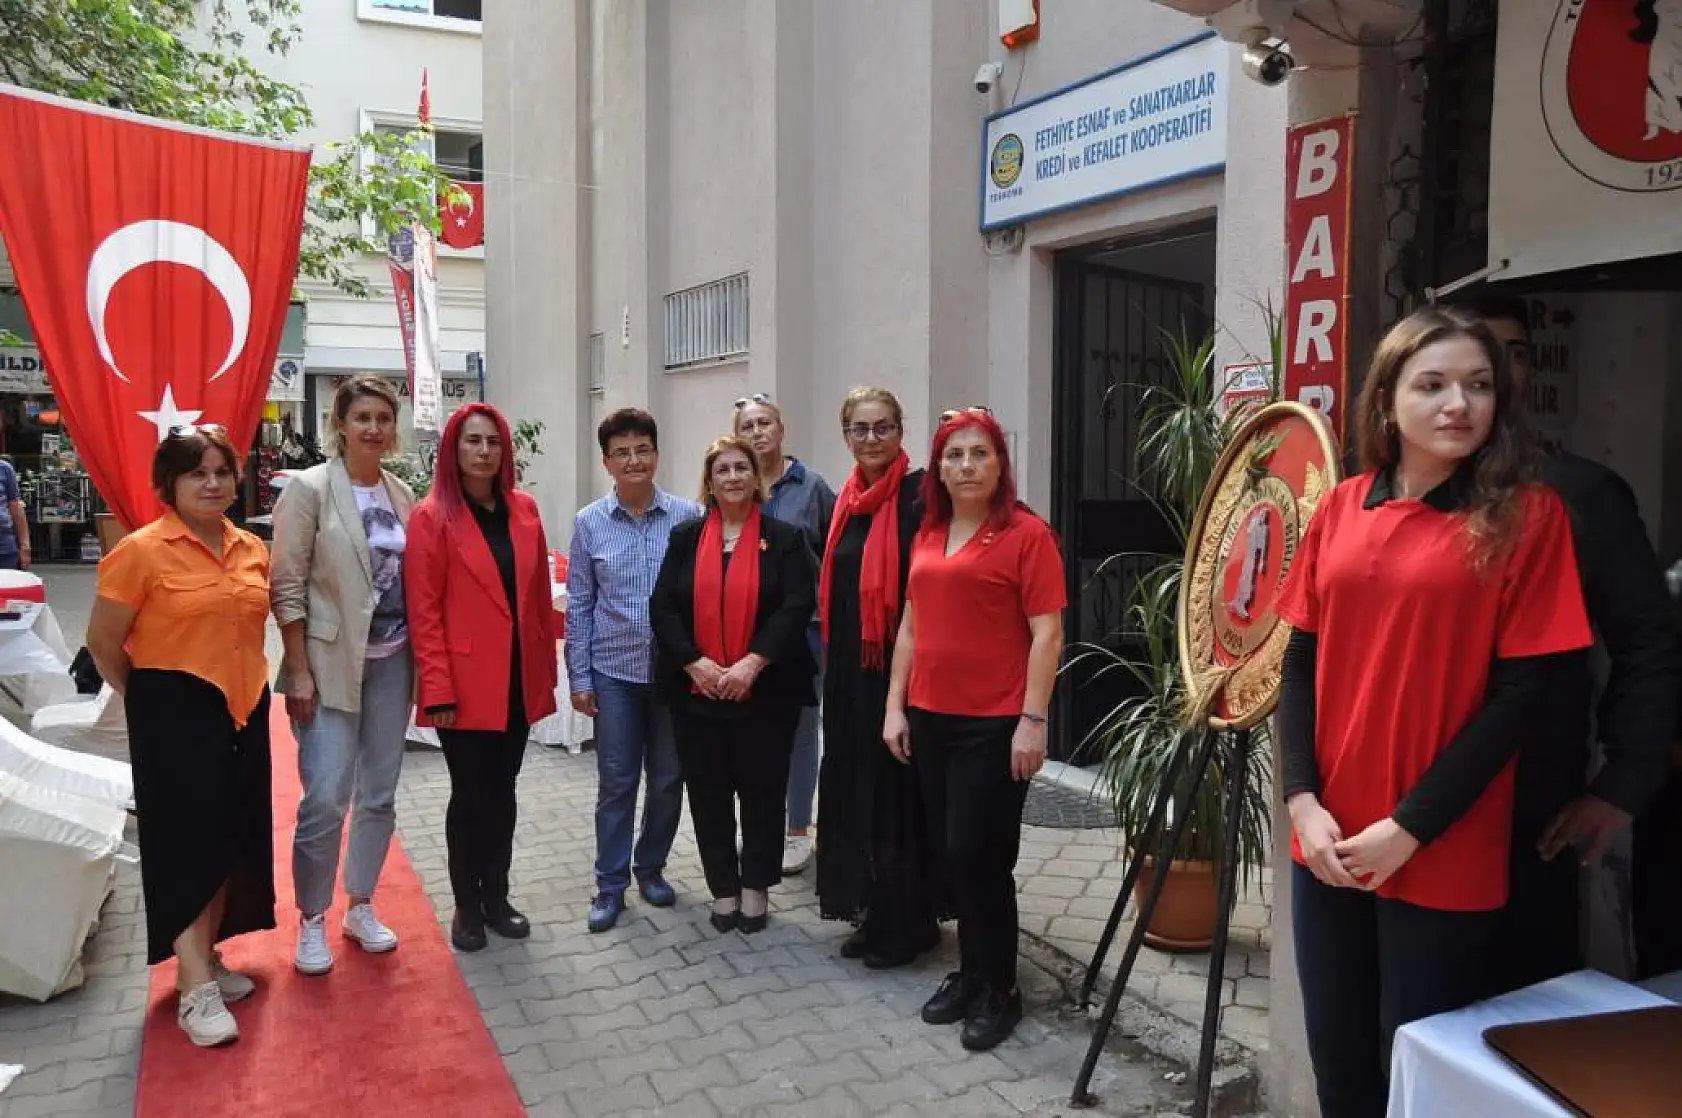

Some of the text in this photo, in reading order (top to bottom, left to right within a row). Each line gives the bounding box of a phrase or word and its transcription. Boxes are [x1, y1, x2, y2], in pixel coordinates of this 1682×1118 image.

[1035, 72, 1215, 151] FETHİYE ESNAF ve SANATKARLAR
[1036, 101, 1212, 181] KREDİ ve KEFALET KOOPERATİFİ
